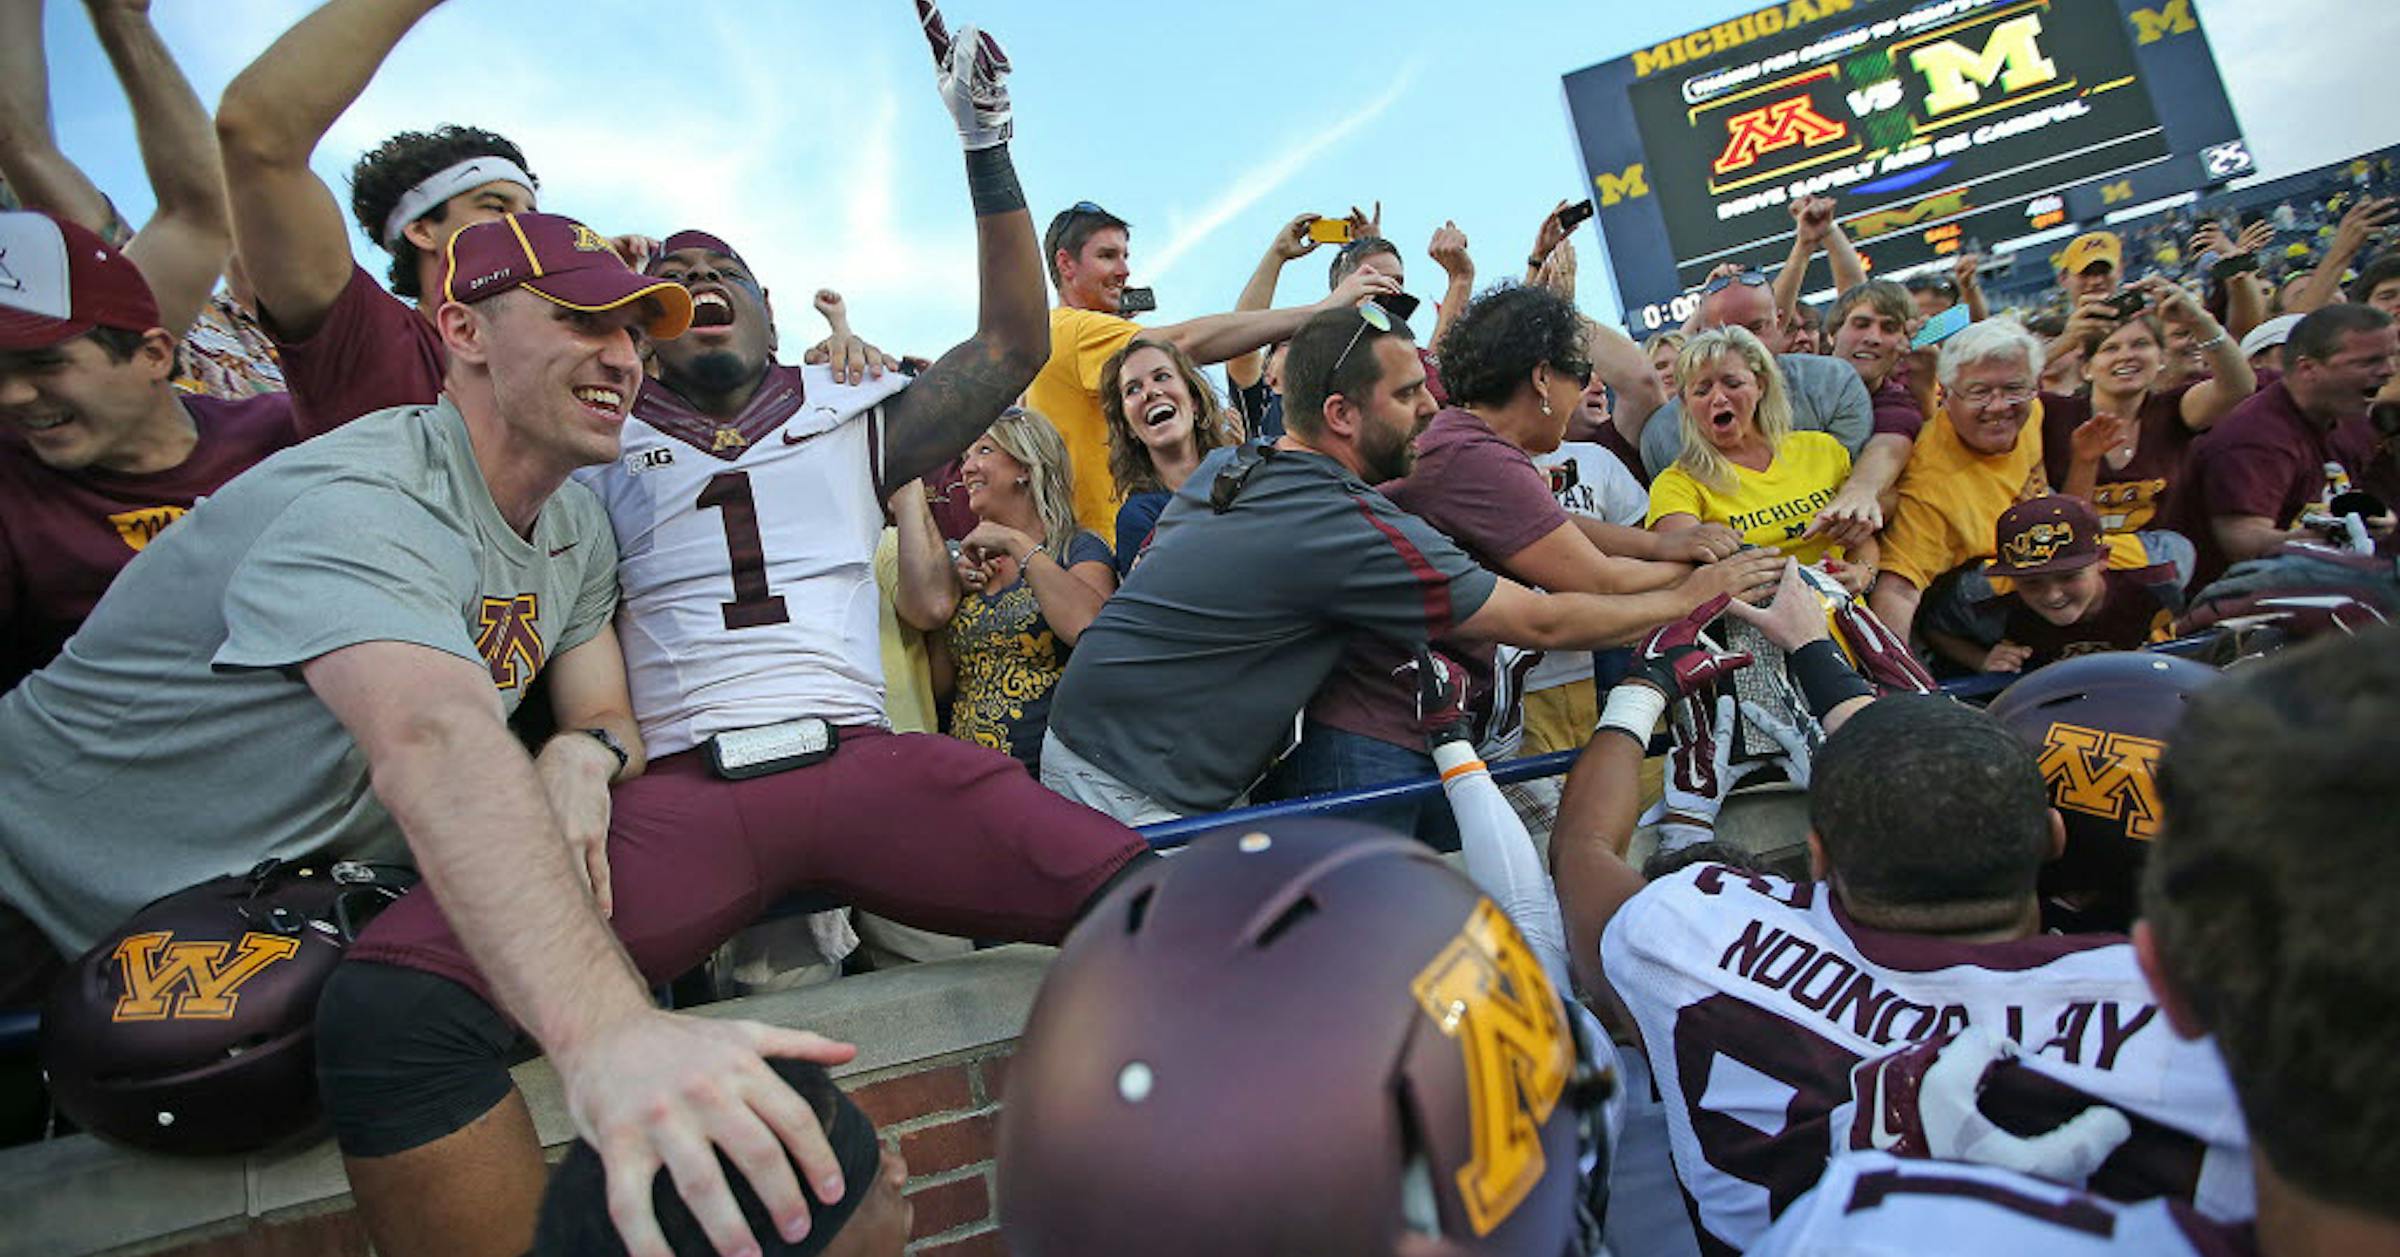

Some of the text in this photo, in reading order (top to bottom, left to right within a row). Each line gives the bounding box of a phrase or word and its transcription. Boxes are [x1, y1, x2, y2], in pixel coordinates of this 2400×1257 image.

[2129, 0, 2197, 46] M
[1909, 13, 2057, 116] M
[1595, 162, 1649, 208] M
[2207, 141, 2251, 174] 25
[696, 471, 790, 630] 1
[2036, 721, 2168, 841] M
